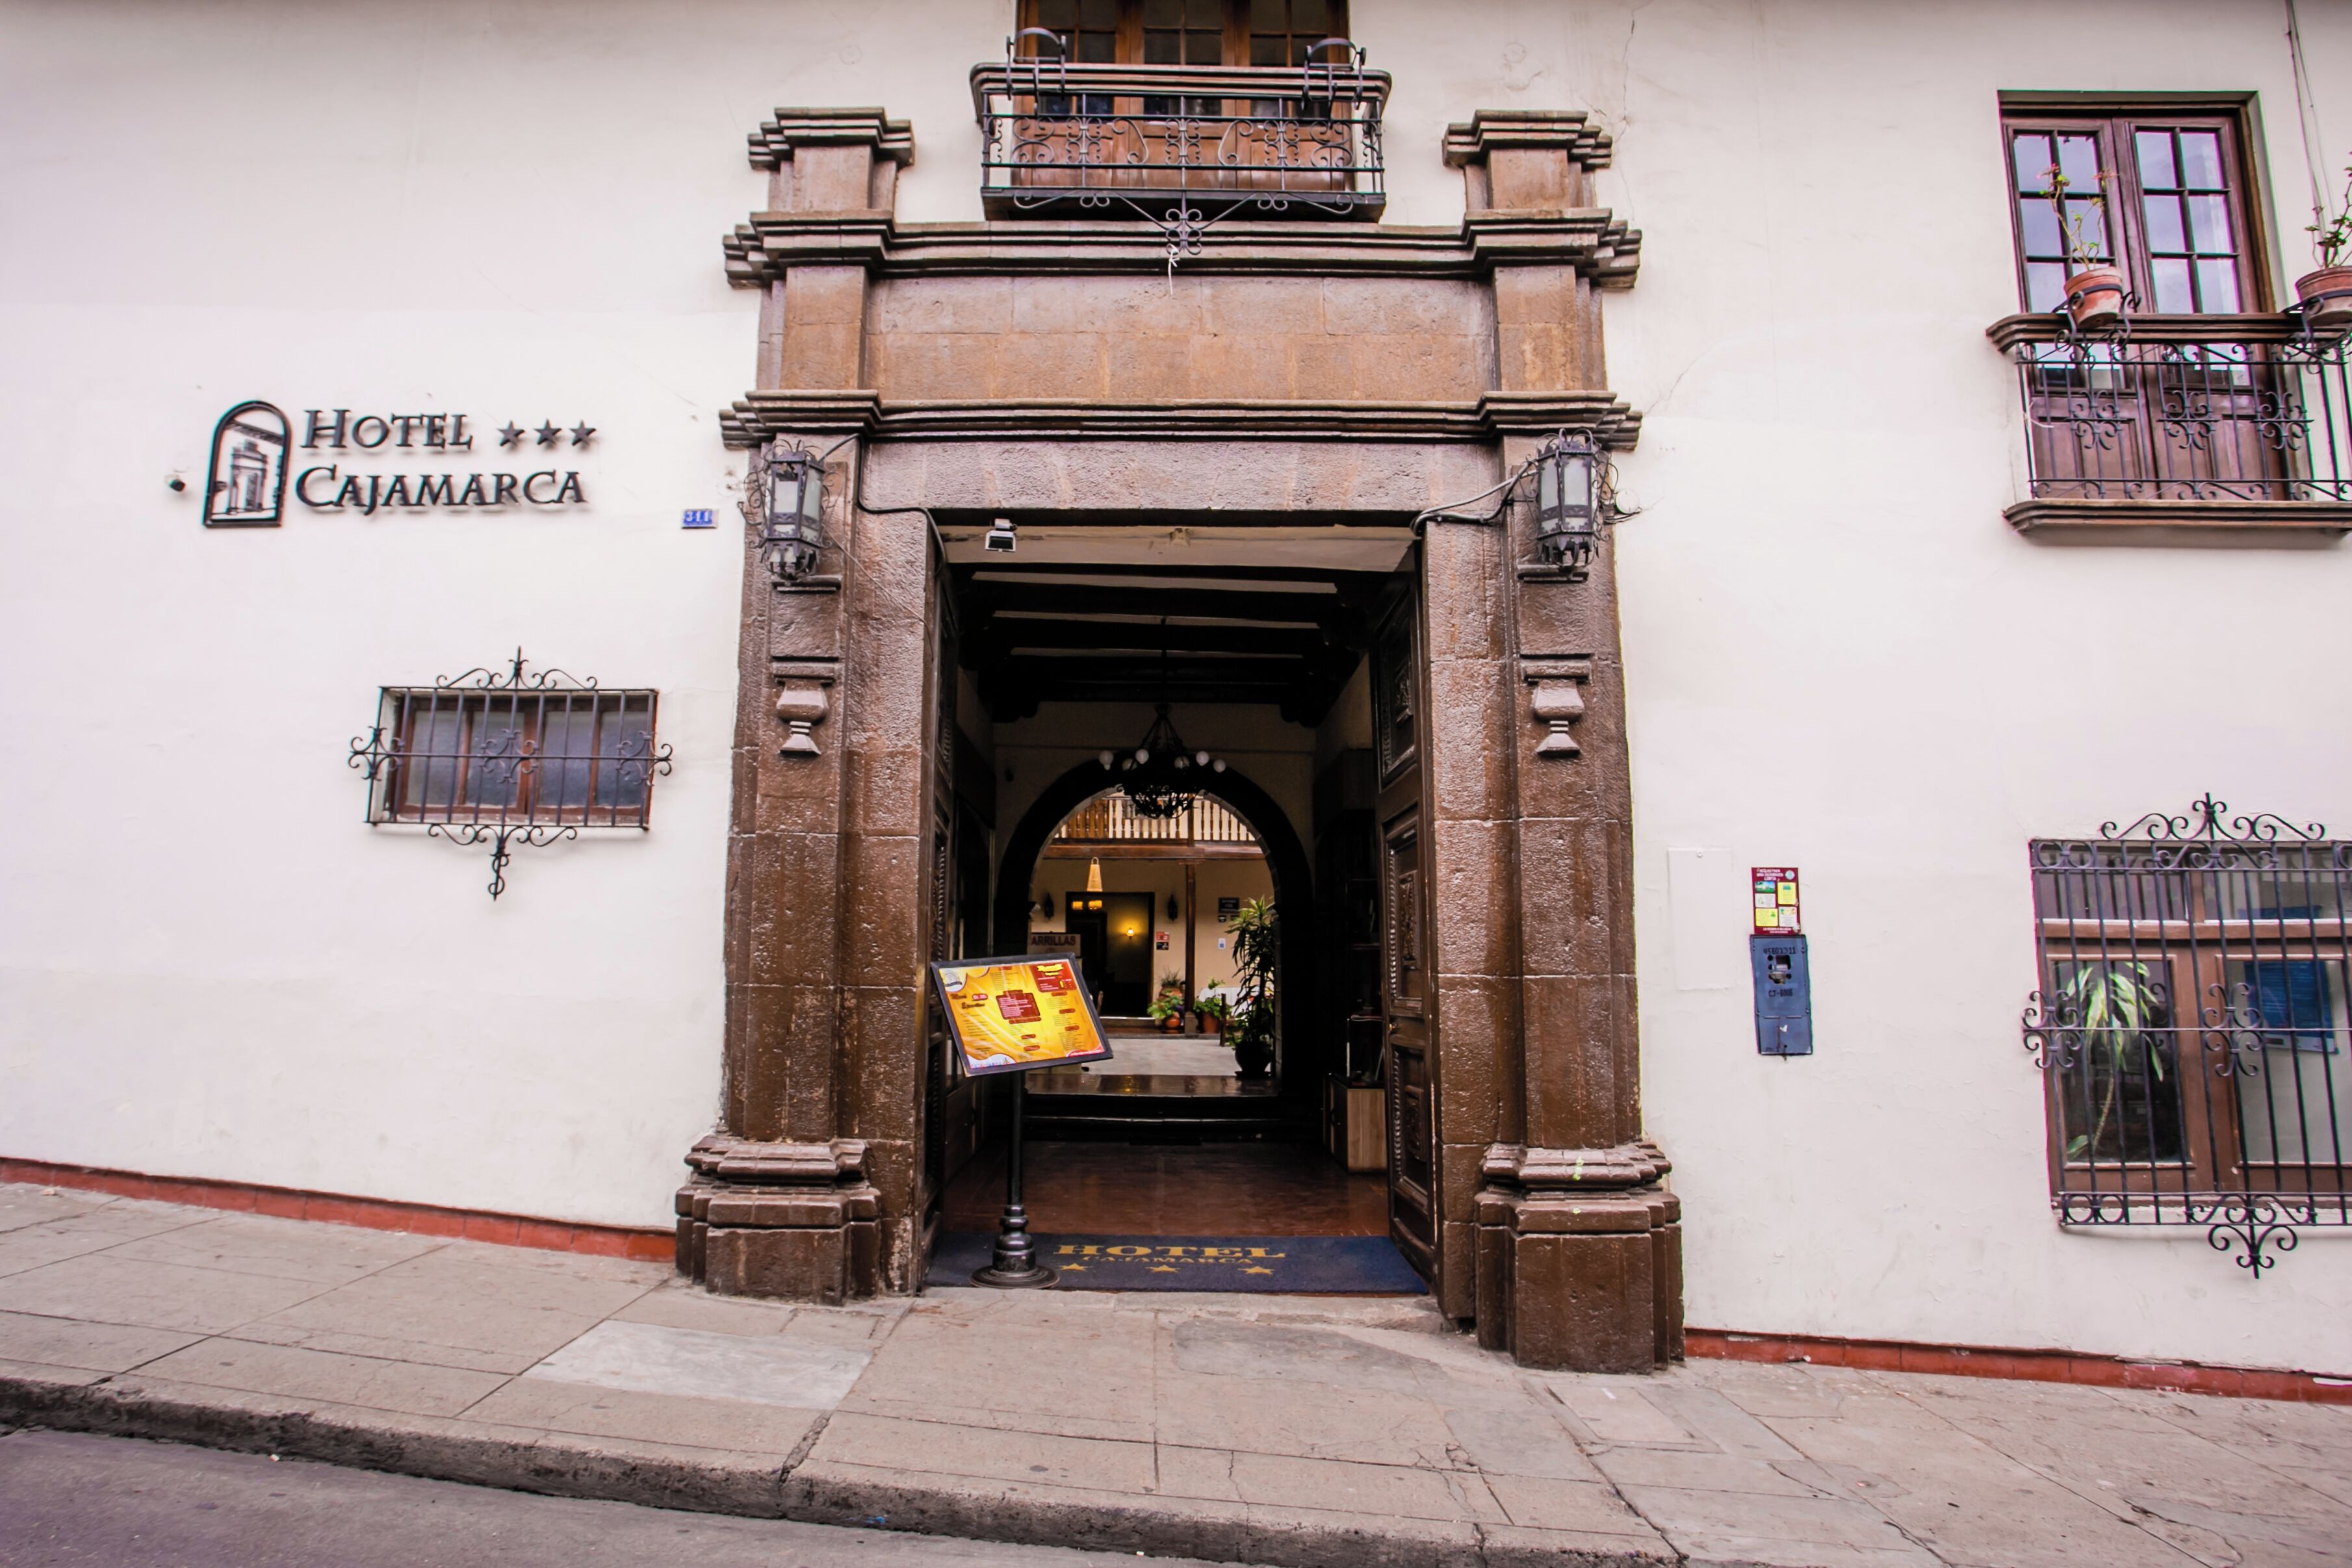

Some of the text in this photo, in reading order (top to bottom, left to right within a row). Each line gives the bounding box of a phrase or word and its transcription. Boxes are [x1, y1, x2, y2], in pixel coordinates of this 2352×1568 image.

[300, 409, 473, 450] HOTEL
[295, 463, 588, 516] CAJAMARCA
[1053, 1244, 1286, 1258] HOTEL
